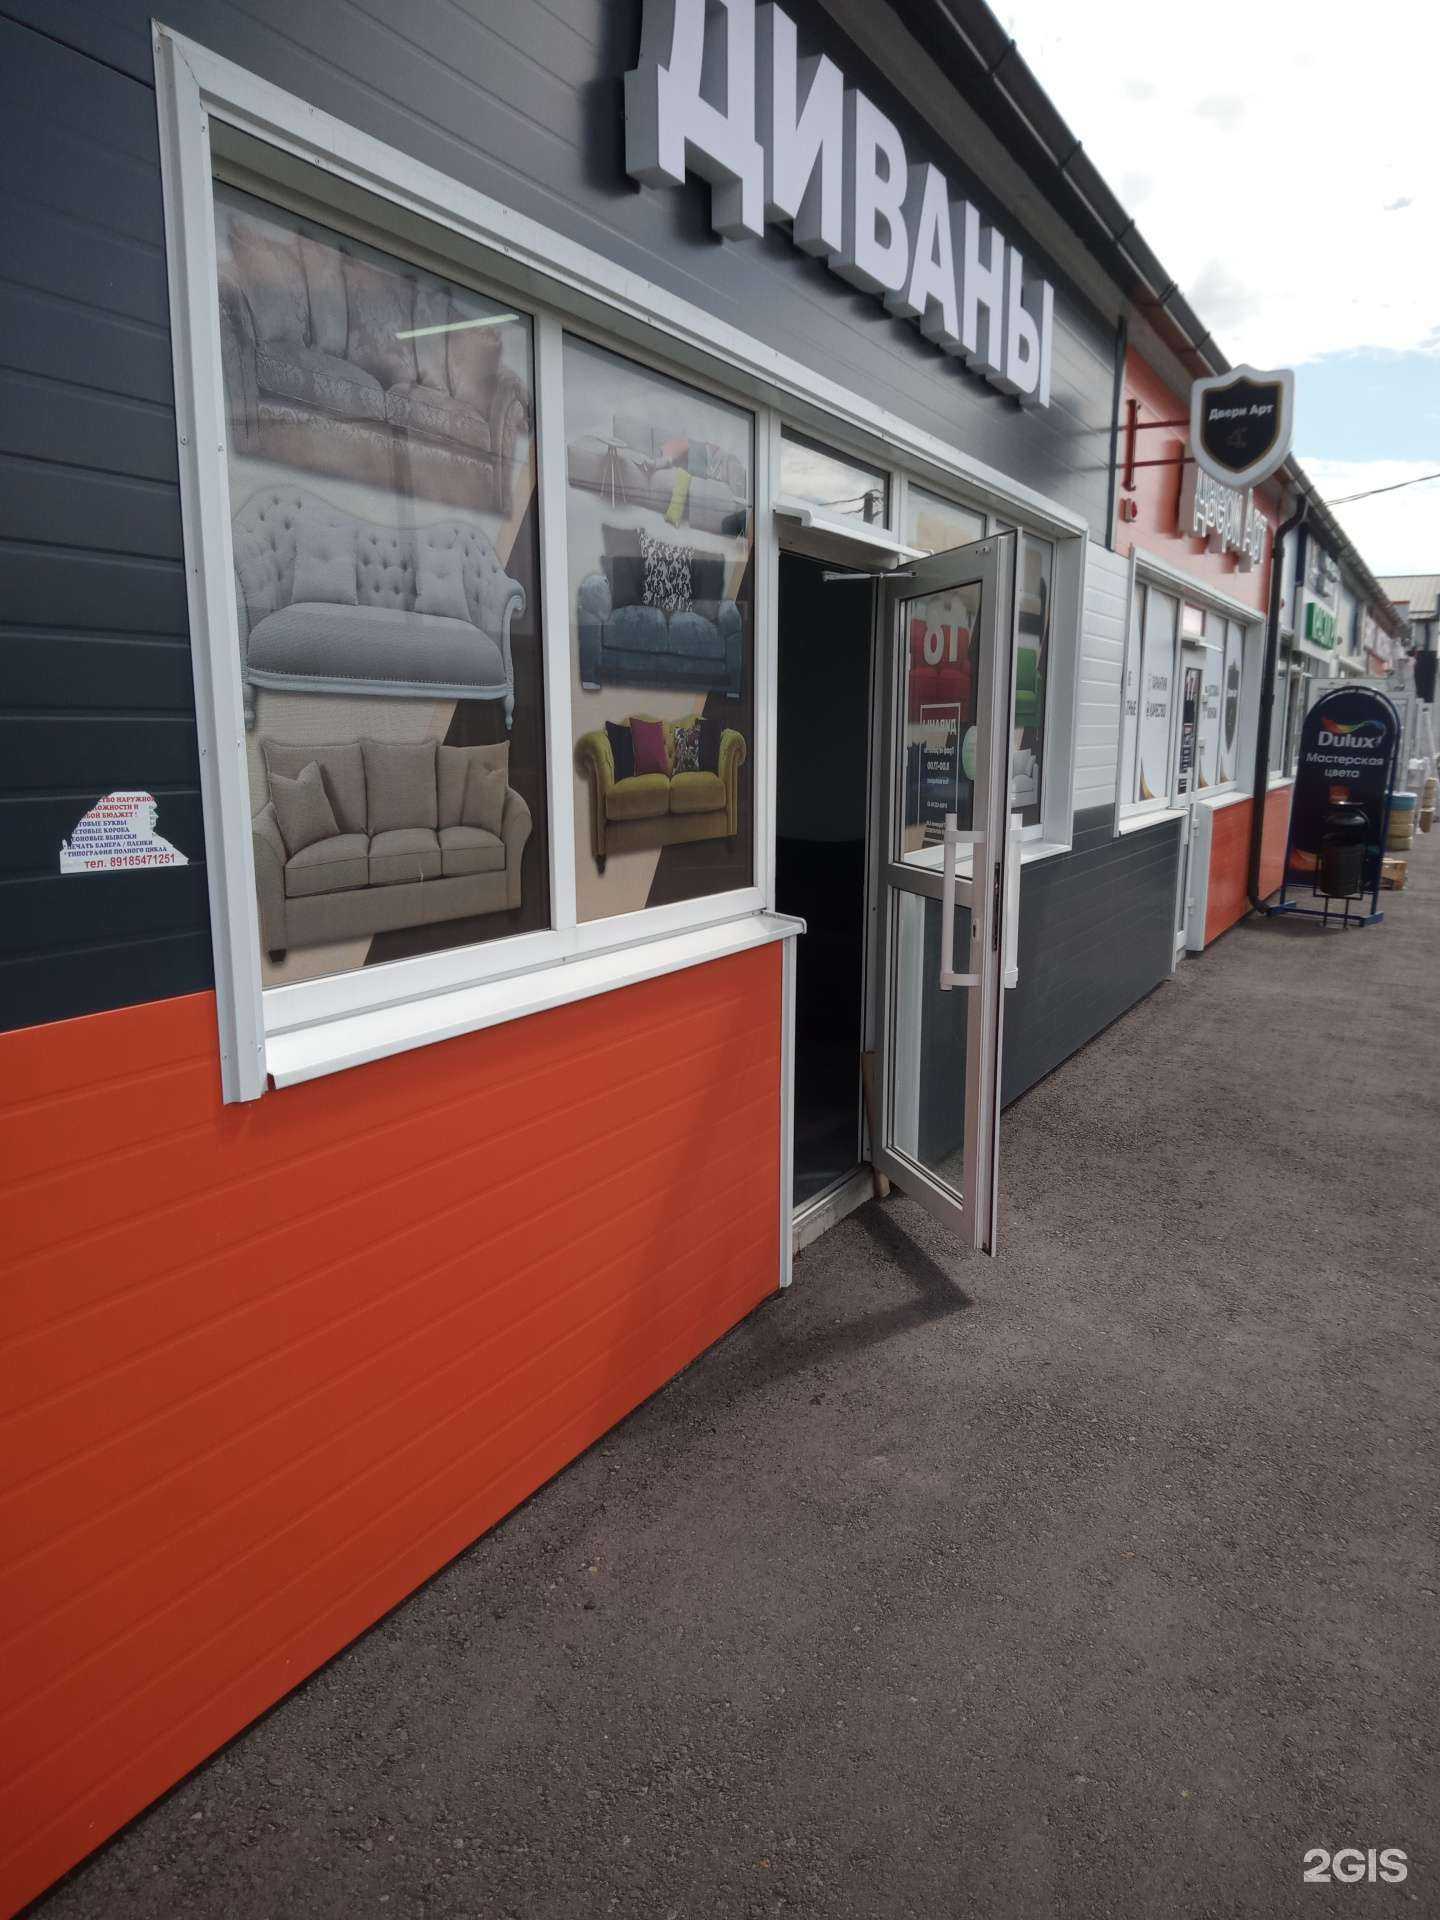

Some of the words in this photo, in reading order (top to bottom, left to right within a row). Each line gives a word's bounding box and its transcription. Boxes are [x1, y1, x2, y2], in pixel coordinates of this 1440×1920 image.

[655, 0, 1054, 408] ДИВАНЫ
[1209, 408, 1247, 421] Двери
[1249, 404, 1274, 417] Арт
[1317, 730, 1376, 748] Dulux
[1305, 752, 1384, 766] Мастерская
[1324, 769, 1360, 778] цвета
[84, 860, 107, 869] тел.
[110, 853, 176, 867] 89185471251
